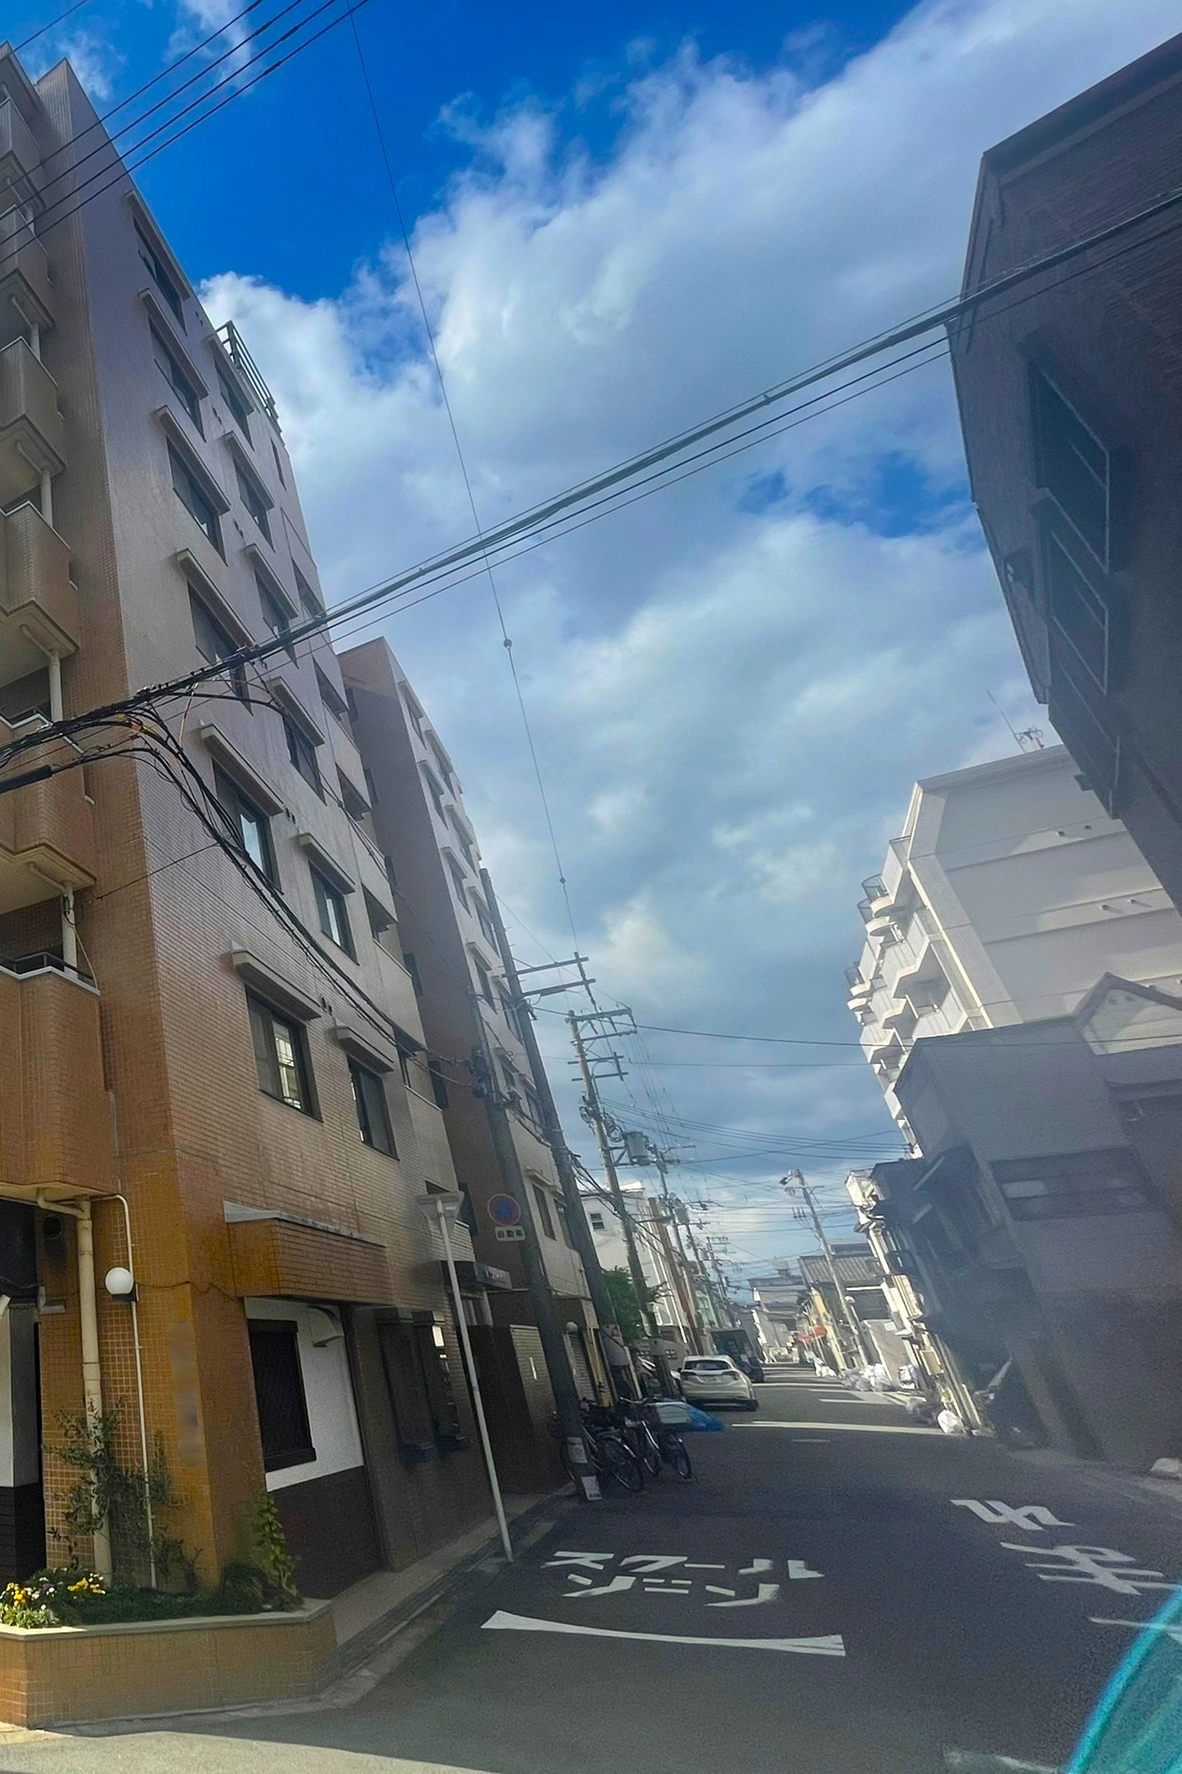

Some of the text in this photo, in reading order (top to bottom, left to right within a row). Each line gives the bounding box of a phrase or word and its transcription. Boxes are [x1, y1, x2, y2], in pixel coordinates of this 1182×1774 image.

[540, 1550, 825, 1580] スクール
[562, 1575, 780, 1607] ゾーン
